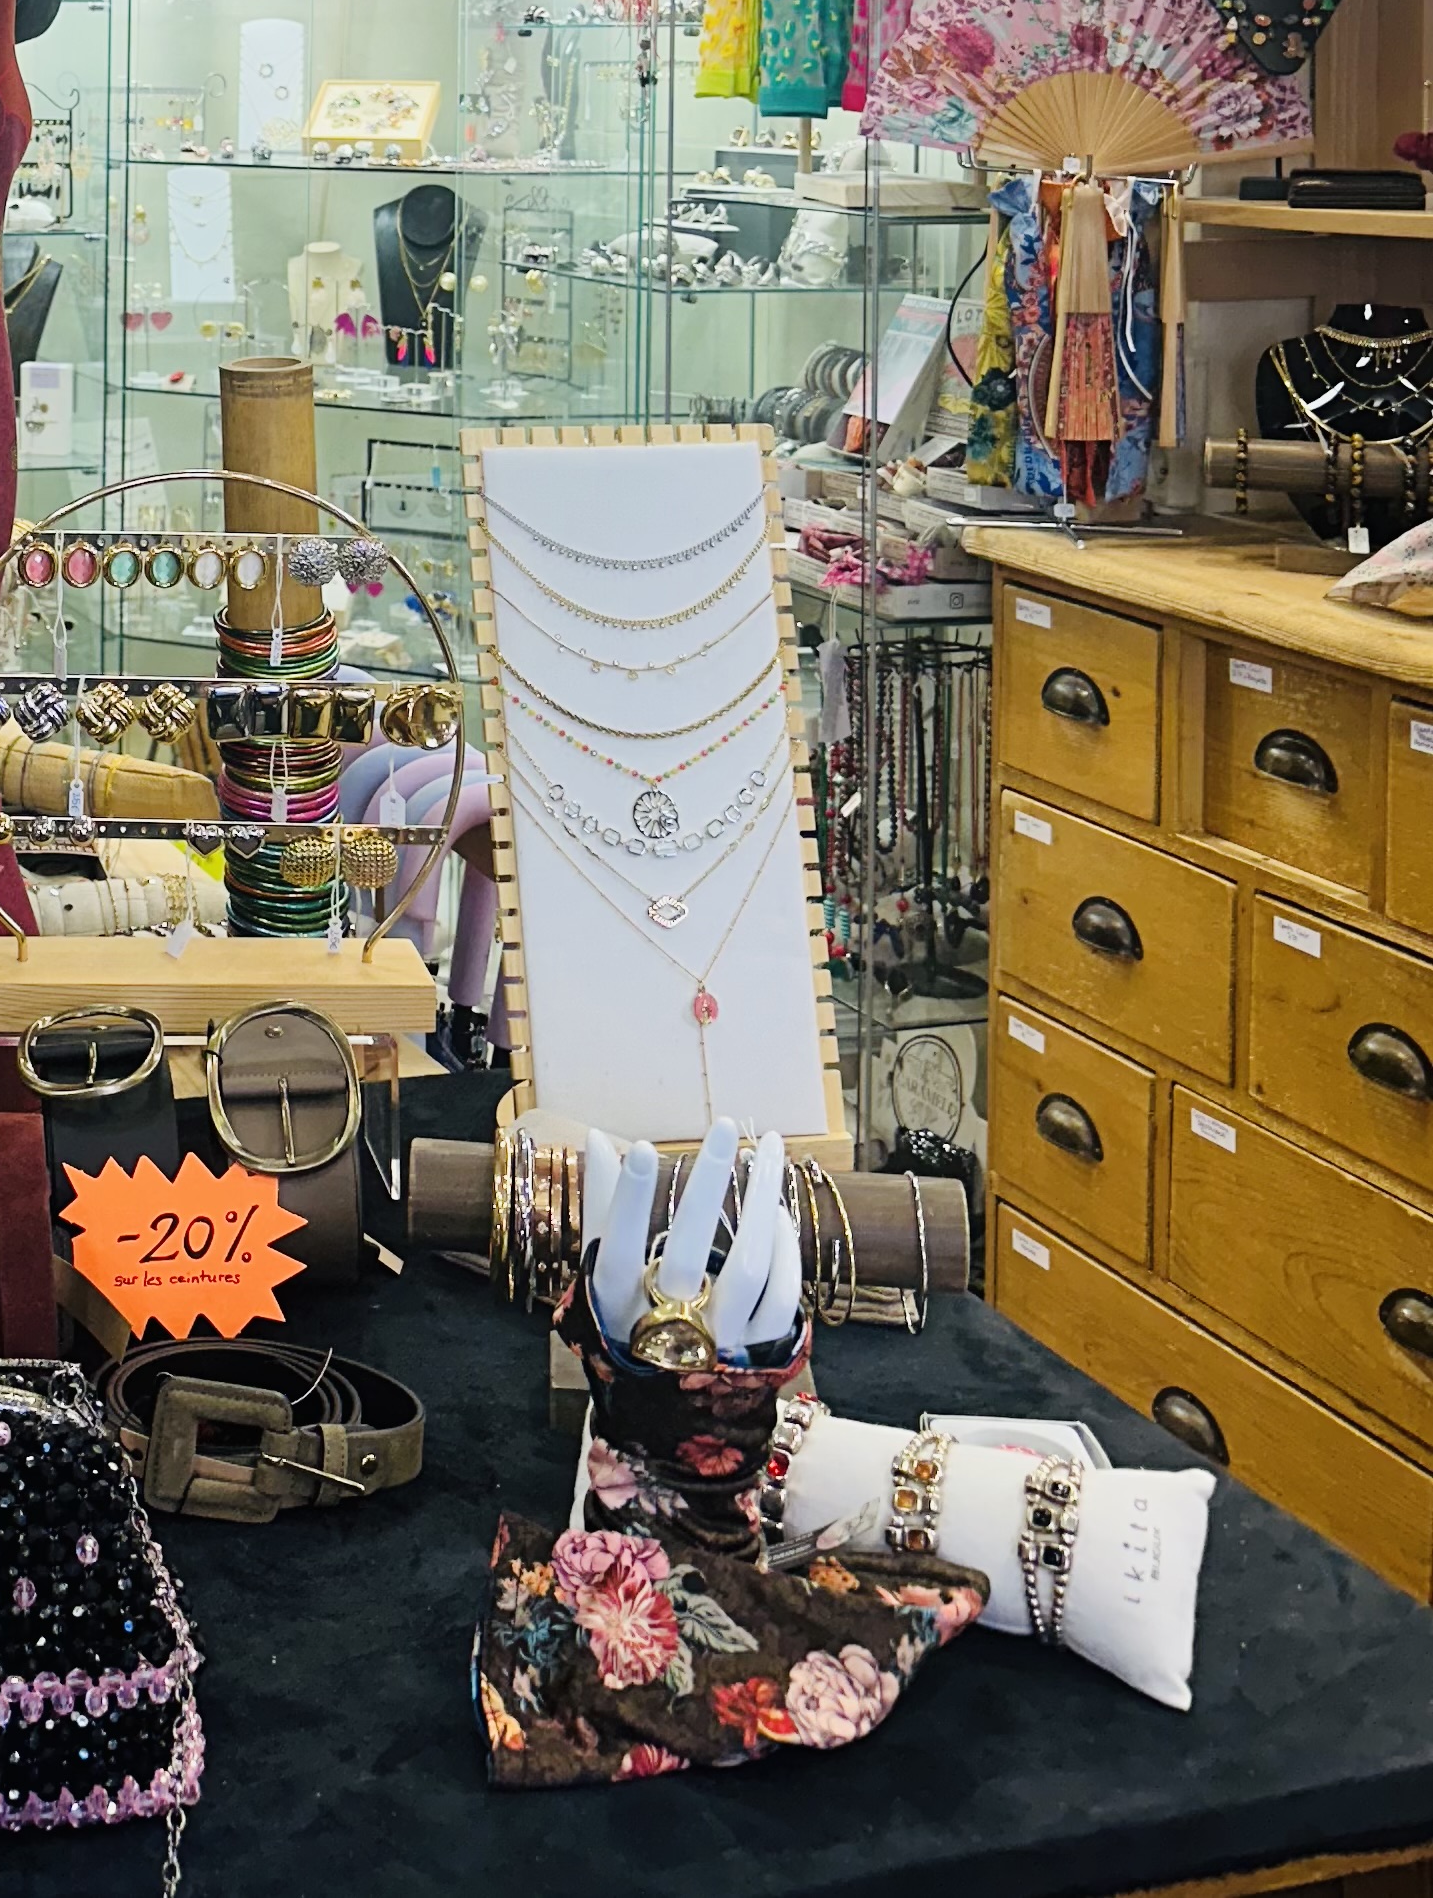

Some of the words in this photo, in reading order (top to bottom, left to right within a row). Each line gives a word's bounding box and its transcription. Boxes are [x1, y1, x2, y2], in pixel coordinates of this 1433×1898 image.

[117, 1204, 260, 1264] -20%
[114, 1275, 139, 1287] sur
[143, 1270, 163, 1287] les
[169, 1269, 241, 1285] ceintures
